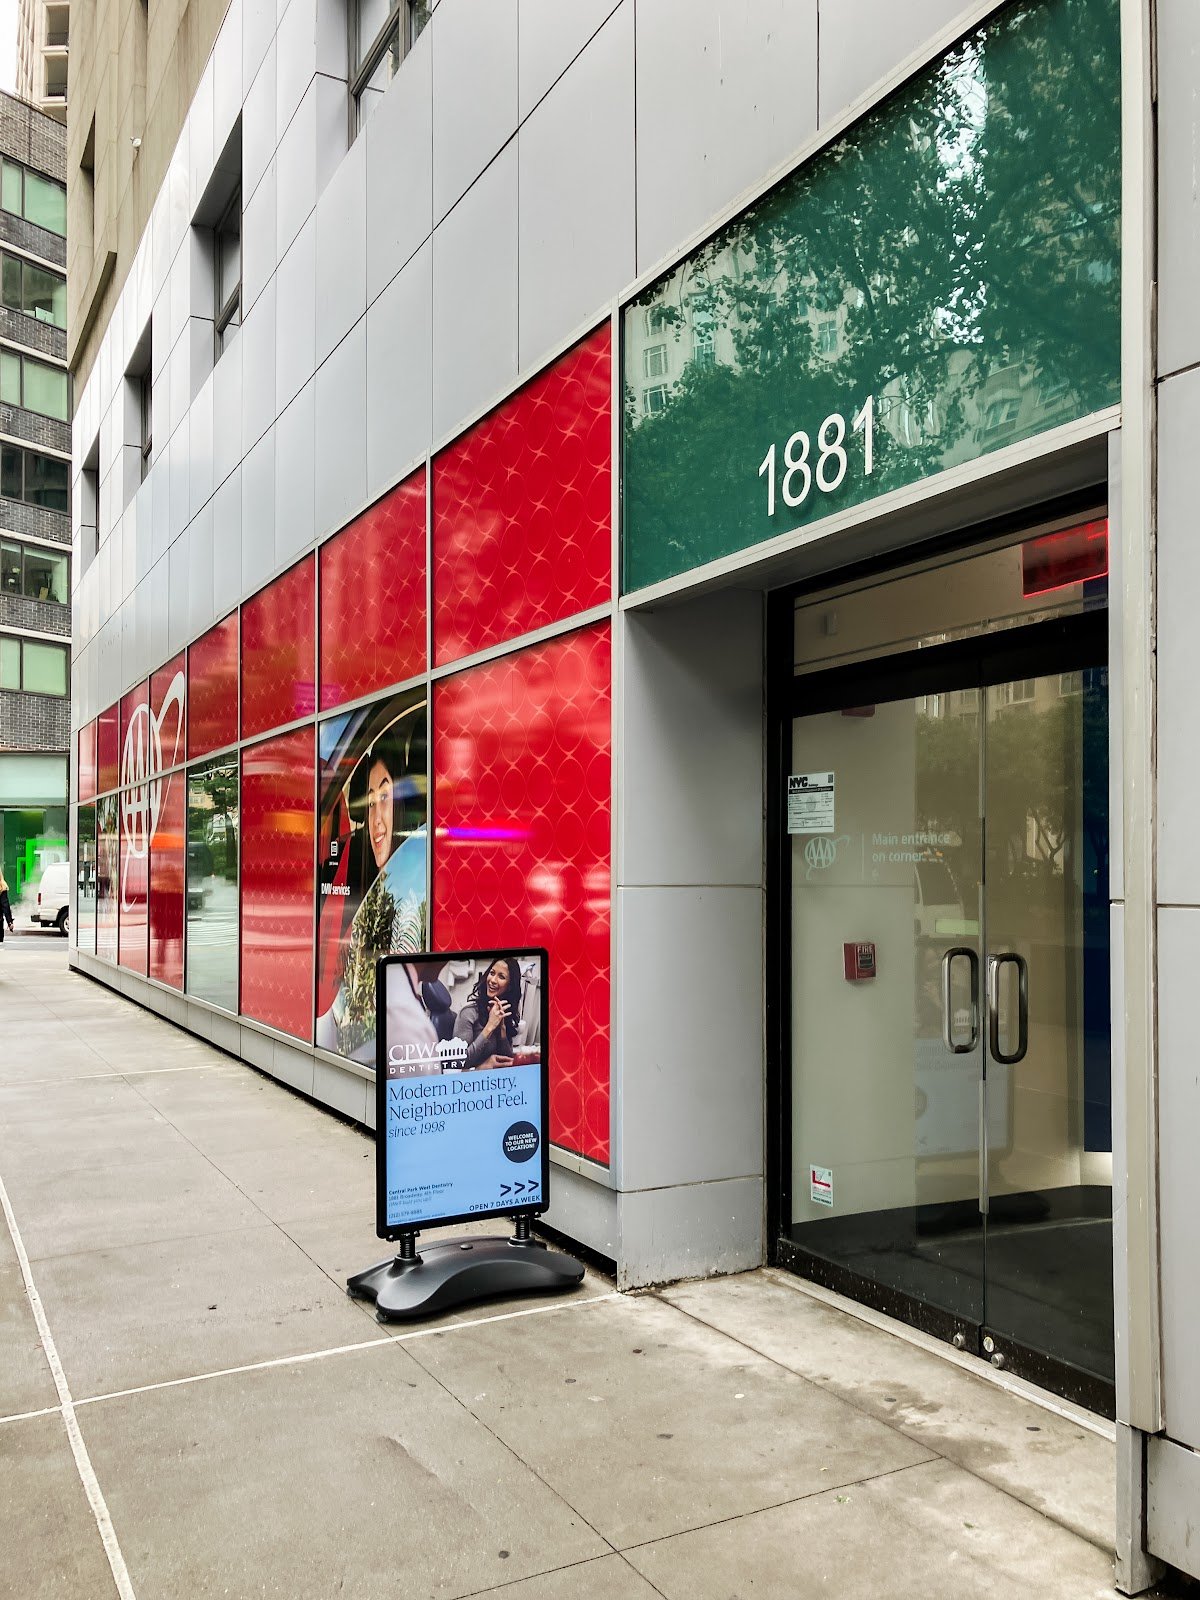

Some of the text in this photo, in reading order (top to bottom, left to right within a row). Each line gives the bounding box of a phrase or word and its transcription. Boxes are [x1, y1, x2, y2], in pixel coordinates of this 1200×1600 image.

[759, 394, 873, 517] 1881
[789, 776, 809, 788] NYC
[872, 831, 950, 845] Main entrance
[806, 837, 836, 868] AAA
[872, 852, 887, 863] on
[332, 882, 350, 896] services
[857, 944, 873, 954] FIRE
[388, 1041, 437, 1062] CPW
[389, 1060, 468, 1075] DENTISTRY
[389, 1076, 517, 1102] Modern Dentistry.
[389, 1091, 528, 1121] Neighborhood Feel.
[388, 1120, 446, 1139] since 1998
[507, 1132, 534, 1141] WELCOME
[507, 1143, 535, 1152] LOCATION!
[469, 1203, 489, 1212] OPEN
[490, 1201, 494, 1209] 7
[495, 1199, 514, 1208] DAYS
[520, 1194, 541, 1203] WEEK
